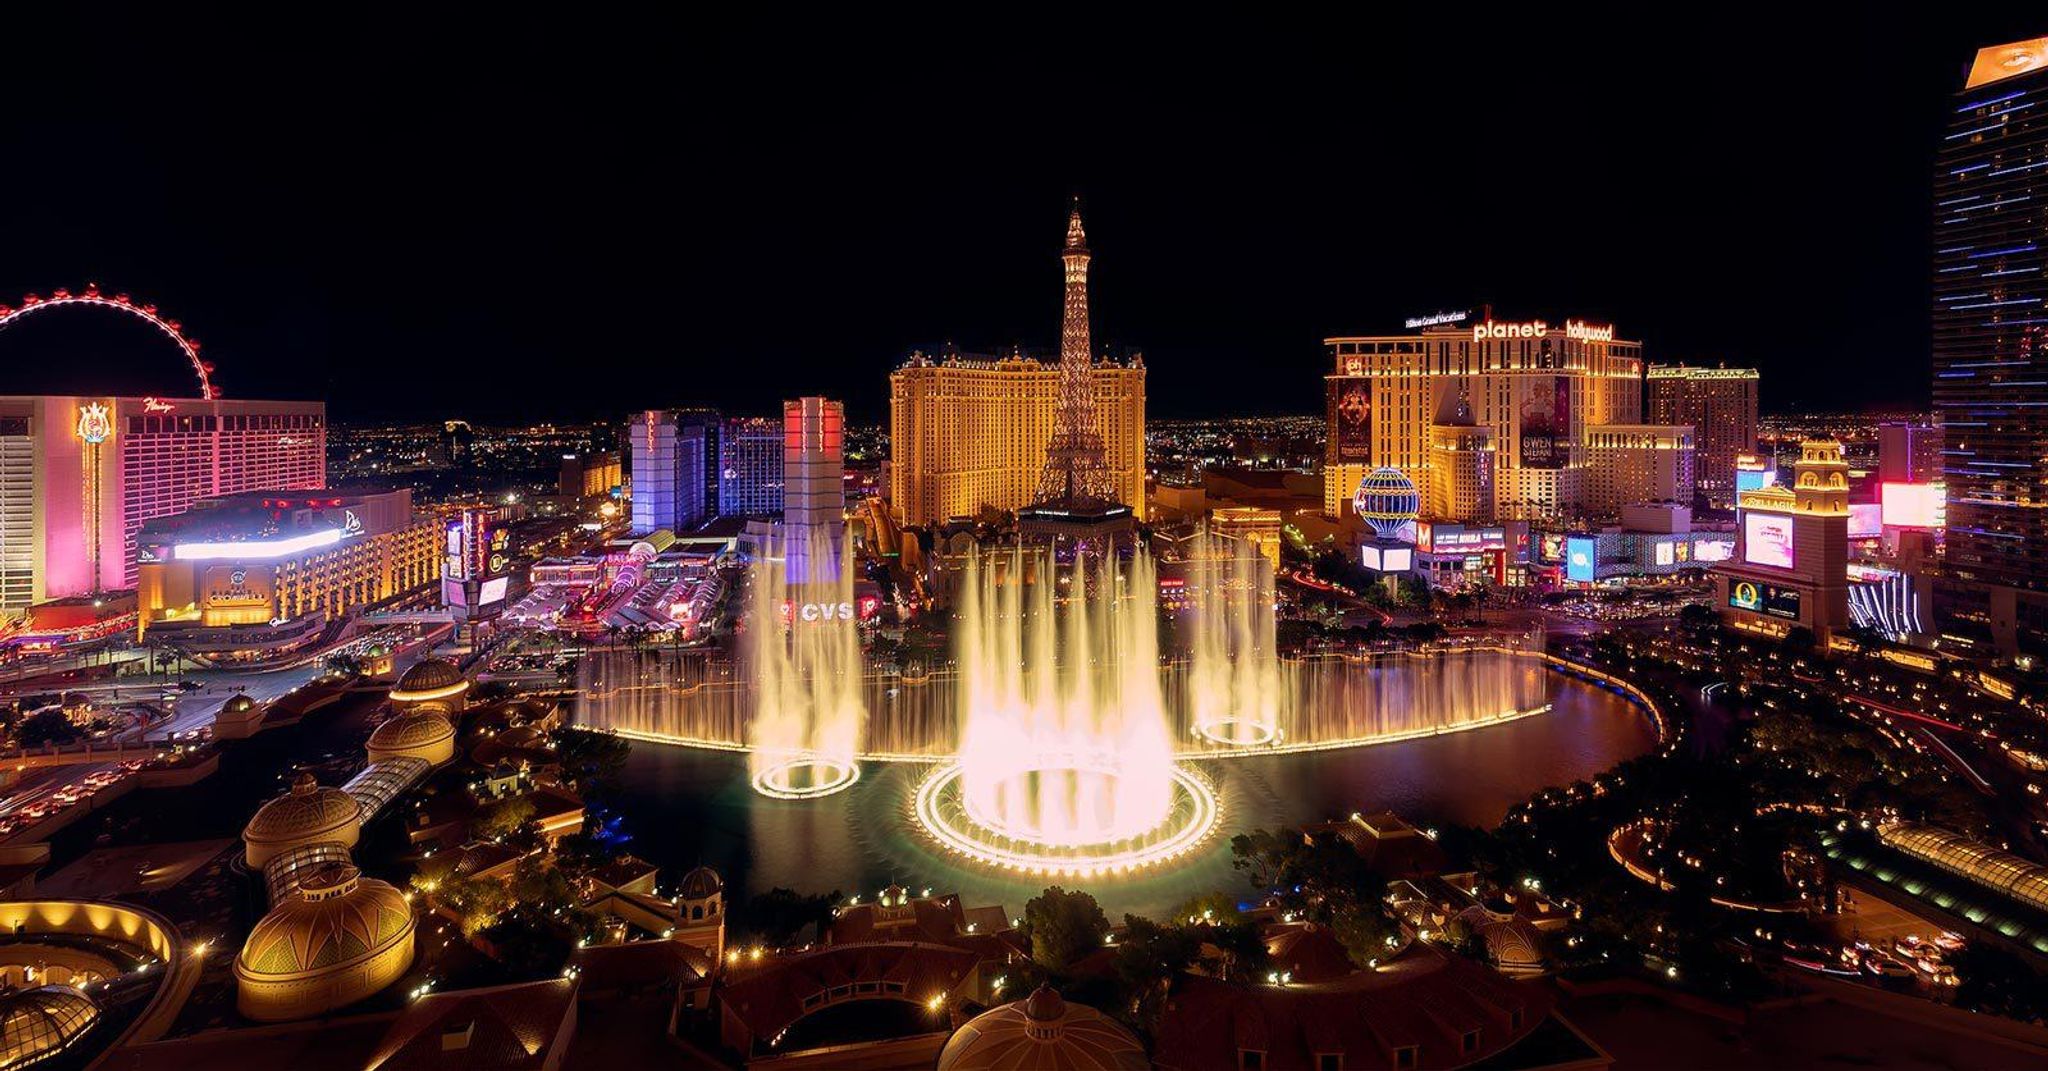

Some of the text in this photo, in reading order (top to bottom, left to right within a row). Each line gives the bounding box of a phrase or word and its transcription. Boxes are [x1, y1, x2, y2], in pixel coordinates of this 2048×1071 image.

[1473, 318, 1547, 342] planet
[1566, 318, 1613, 344] hollywood
[1523, 436, 1552, 448] GWEN
[801, 602, 854, 621] CVS
